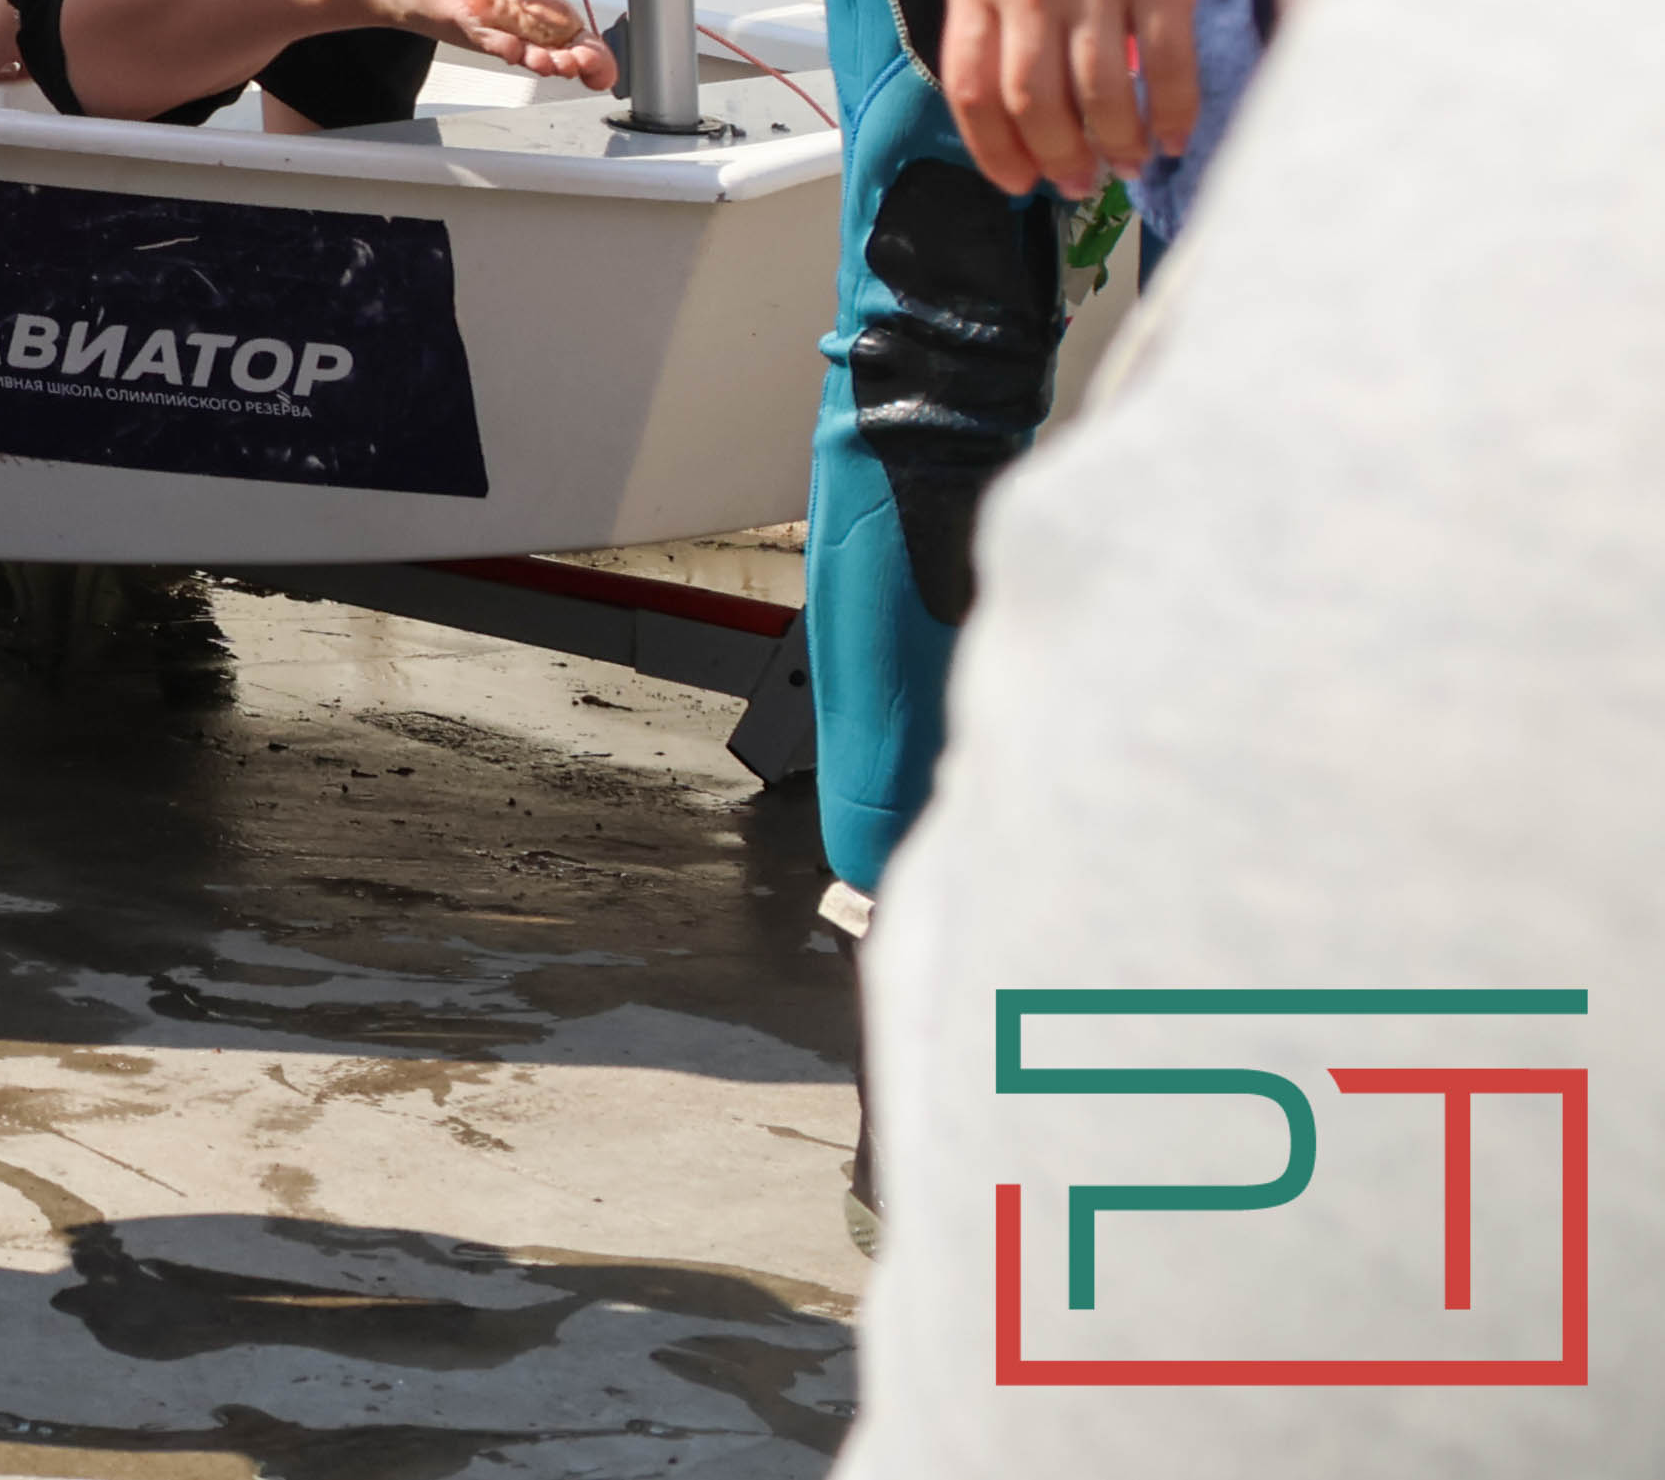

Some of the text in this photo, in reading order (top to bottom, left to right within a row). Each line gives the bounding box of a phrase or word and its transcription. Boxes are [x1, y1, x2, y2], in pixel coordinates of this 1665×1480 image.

[46, 380, 104, 400] ШКОЛА
[105, 387, 242, 413] ОЛИМПИЙСКОГО
[244, 400, 313, 419] РЕЗЕРВА
